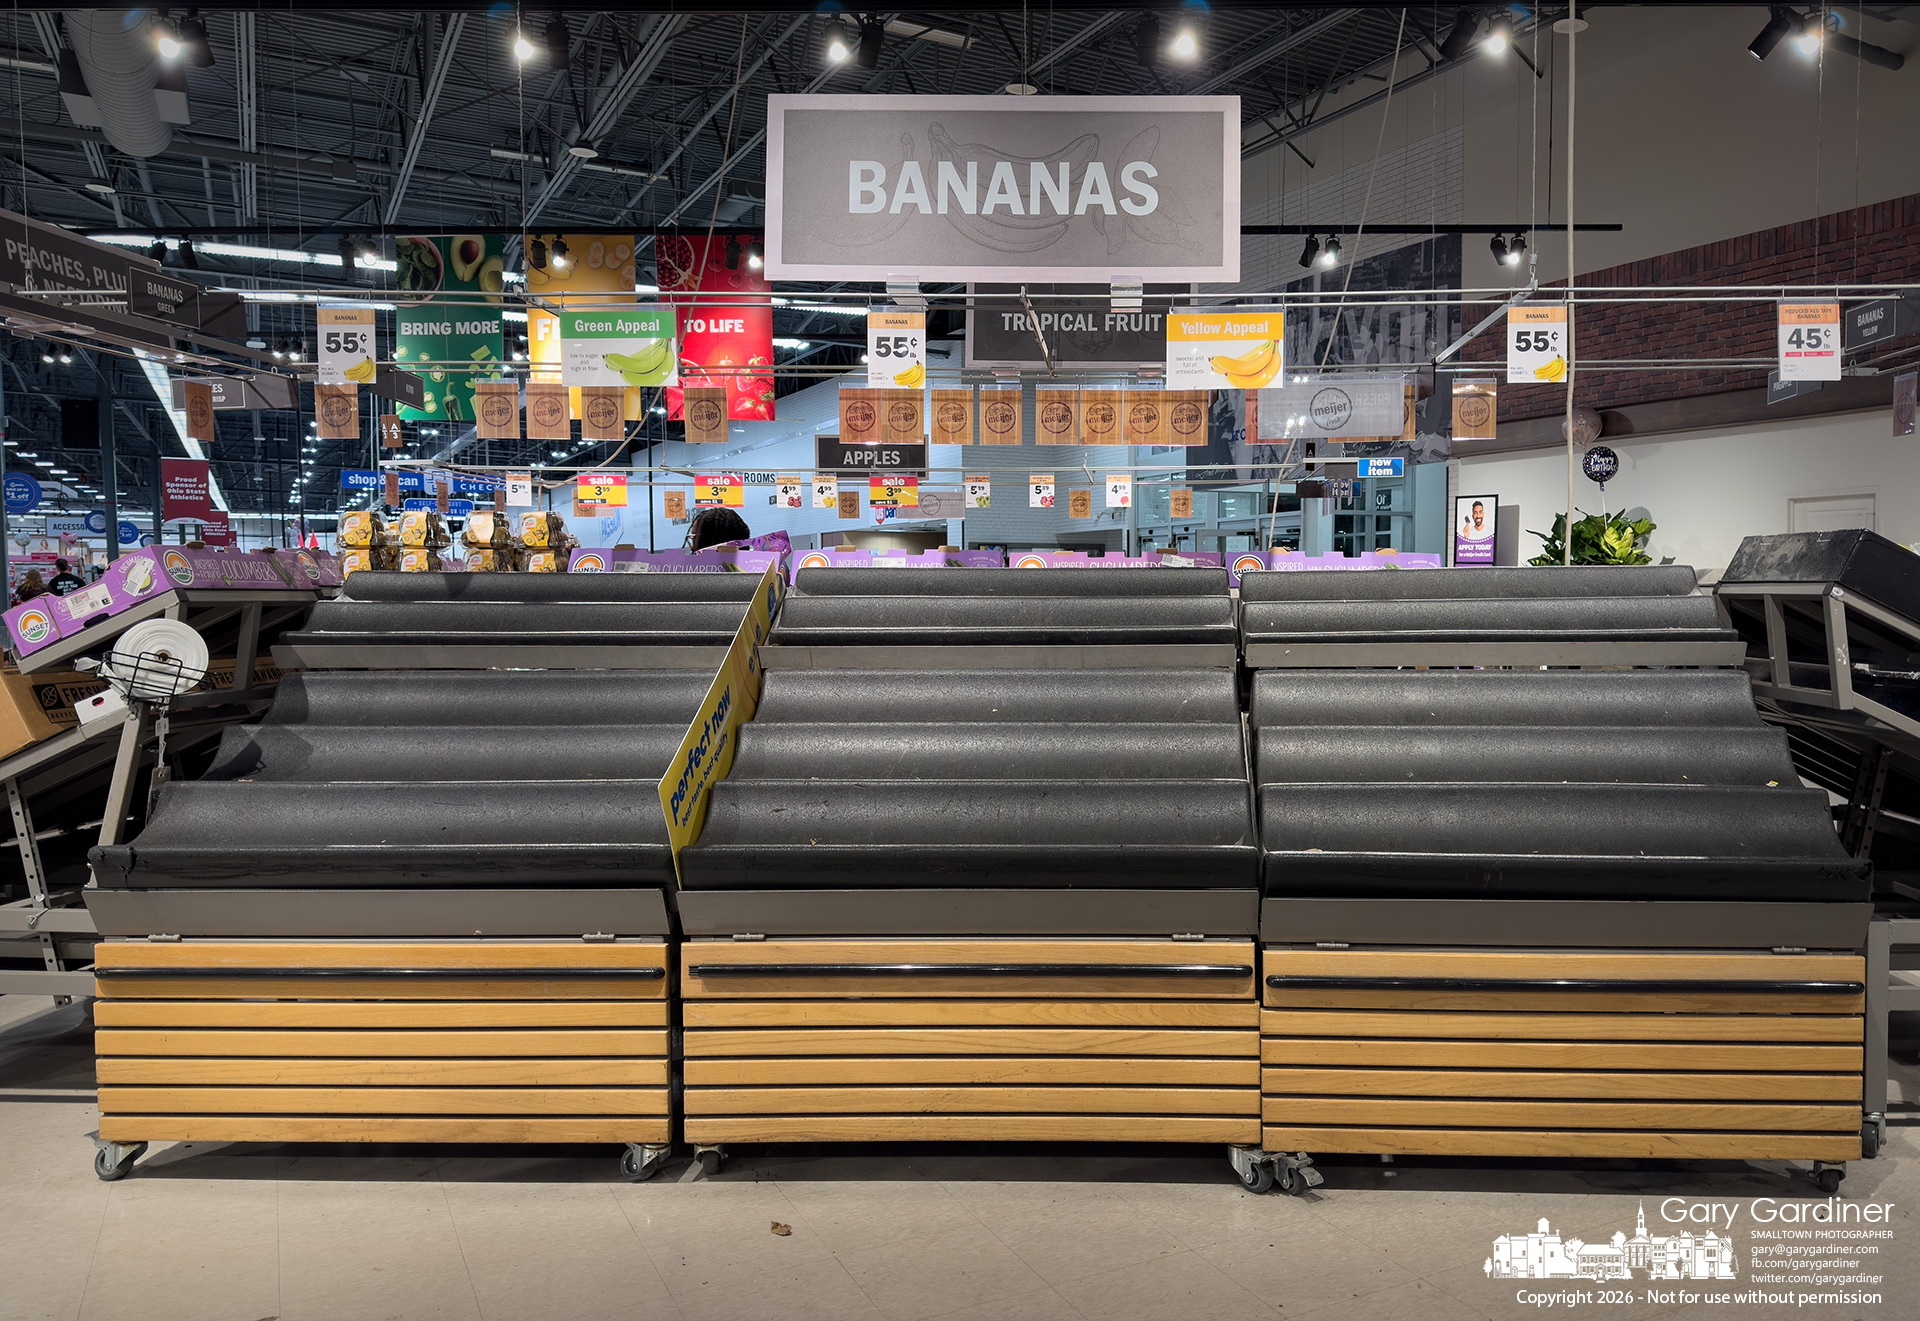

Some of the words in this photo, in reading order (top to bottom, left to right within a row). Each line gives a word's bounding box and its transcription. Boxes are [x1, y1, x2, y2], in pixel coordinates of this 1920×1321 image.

[848, 160, 1160, 216] BANANAS
[5, 238, 91, 288] PEACHES,
[93, 266, 127, 292] PLU
[147, 281, 184, 303] BANANAS
[157, 302, 175, 315] GREEN
[1001, 313, 1098, 332] TROPICAL
[1104, 313, 1162, 332] FRUIT
[1857, 307, 1884, 327] BANANAS
[400, 321, 452, 336] BRING
[455, 320, 500, 335] MORE
[574, 319, 613, 332] Green
[616, 319, 660, 335] Appeal
[684, 319, 706, 333] TO
[709, 319, 745, 333] LIFE
[1181, 322, 1221, 335] Yellow
[1224, 321, 1269, 336] Appeal
[1862, 325, 1878, 337] YELLOW
[324, 405, 349, 419] meijer
[485, 404, 510, 418] meijer
[535, 404, 561, 418] meijer
[590, 405, 615, 419] meijer
[1314, 401, 1348, 416] meijer
[1461, 405, 1488, 418] meijer
[693, 410, 719, 422] meijer
[988, 411, 1013, 424] meijer
[1044, 411, 1070, 424] meijer
[1173, 411, 1199, 424] meijer
[391, 422, 398, 430] A
[393, 432, 398, 440] 3
[843, 450, 901, 465] APPLES
[1369, 459, 1391, 467] new
[1367, 466, 1393, 476] item
[348, 474, 377, 487] shop
[379, 475, 386, 485] &
[397, 476, 418, 486] can
[589, 475, 614, 485] sale
[707, 477, 731, 486] sale
[882, 477, 906, 486] sale
[53, 523, 88, 531] ACCESSO
[168, 566, 193, 577] SUNSET
[221, 560, 278, 581] CUCUMBERS
[22, 622, 49, 639] SUNSET
[670, 720, 711, 827] perfect
[711, 684, 731, 735] now
[703, 756, 714, 781] best
[713, 730, 728, 763] quality
